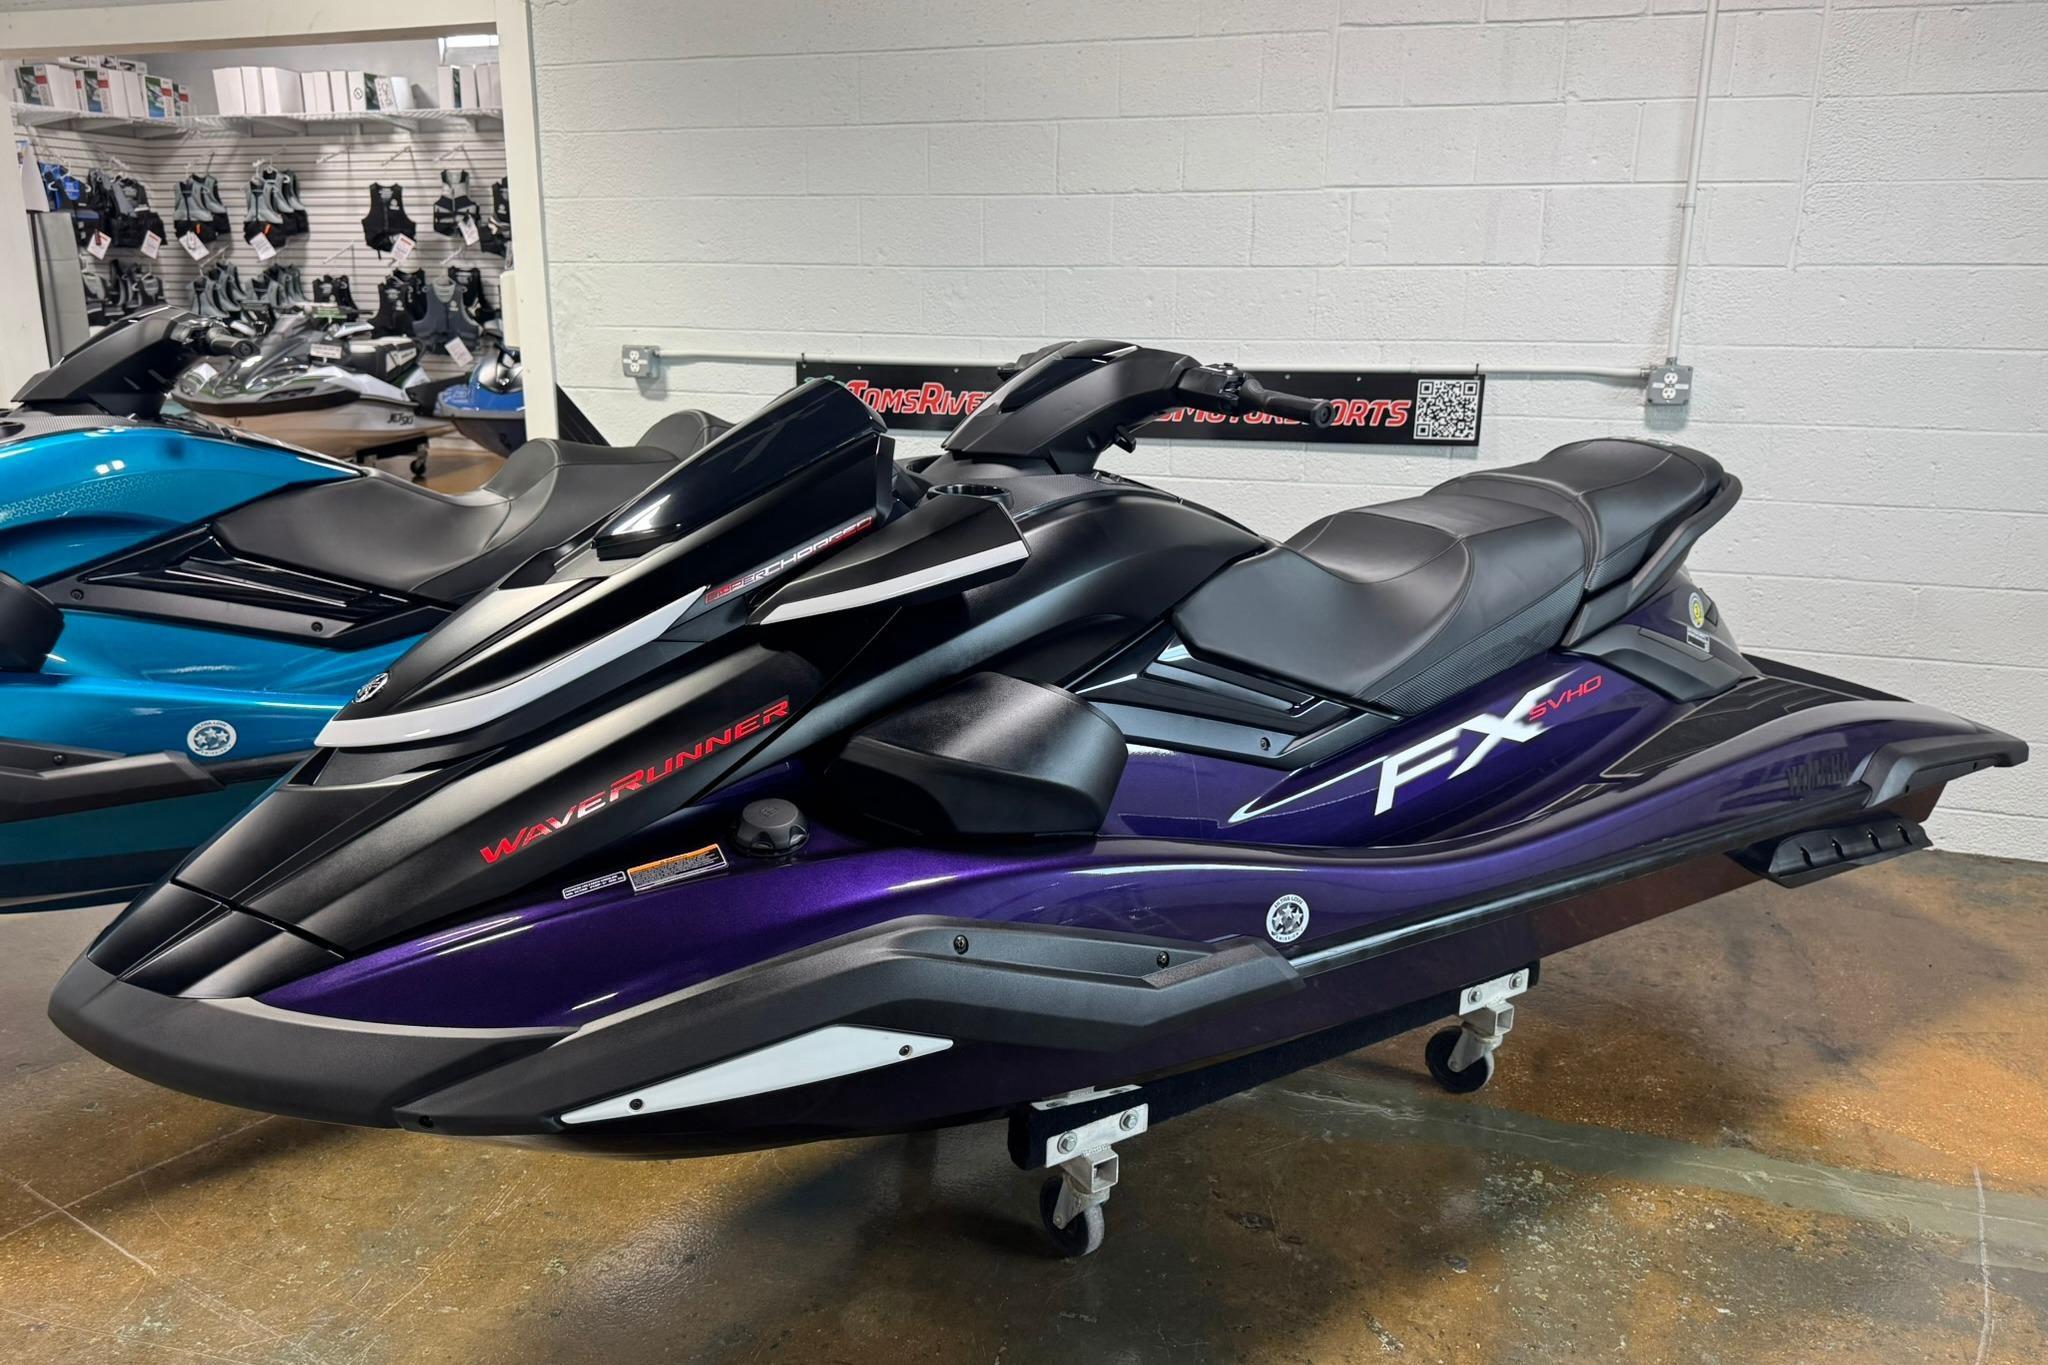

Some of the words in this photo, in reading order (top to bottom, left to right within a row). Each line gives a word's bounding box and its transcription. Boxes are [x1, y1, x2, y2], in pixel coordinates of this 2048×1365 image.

[845, 379, 992, 416] TOMSRIVE
[704, 516, 874, 605] SUPERCHARGED
[1374, 666, 1583, 816] FX
[1528, 675, 1603, 721] SVHO
[480, 698, 790, 864] WAVERUNNER
